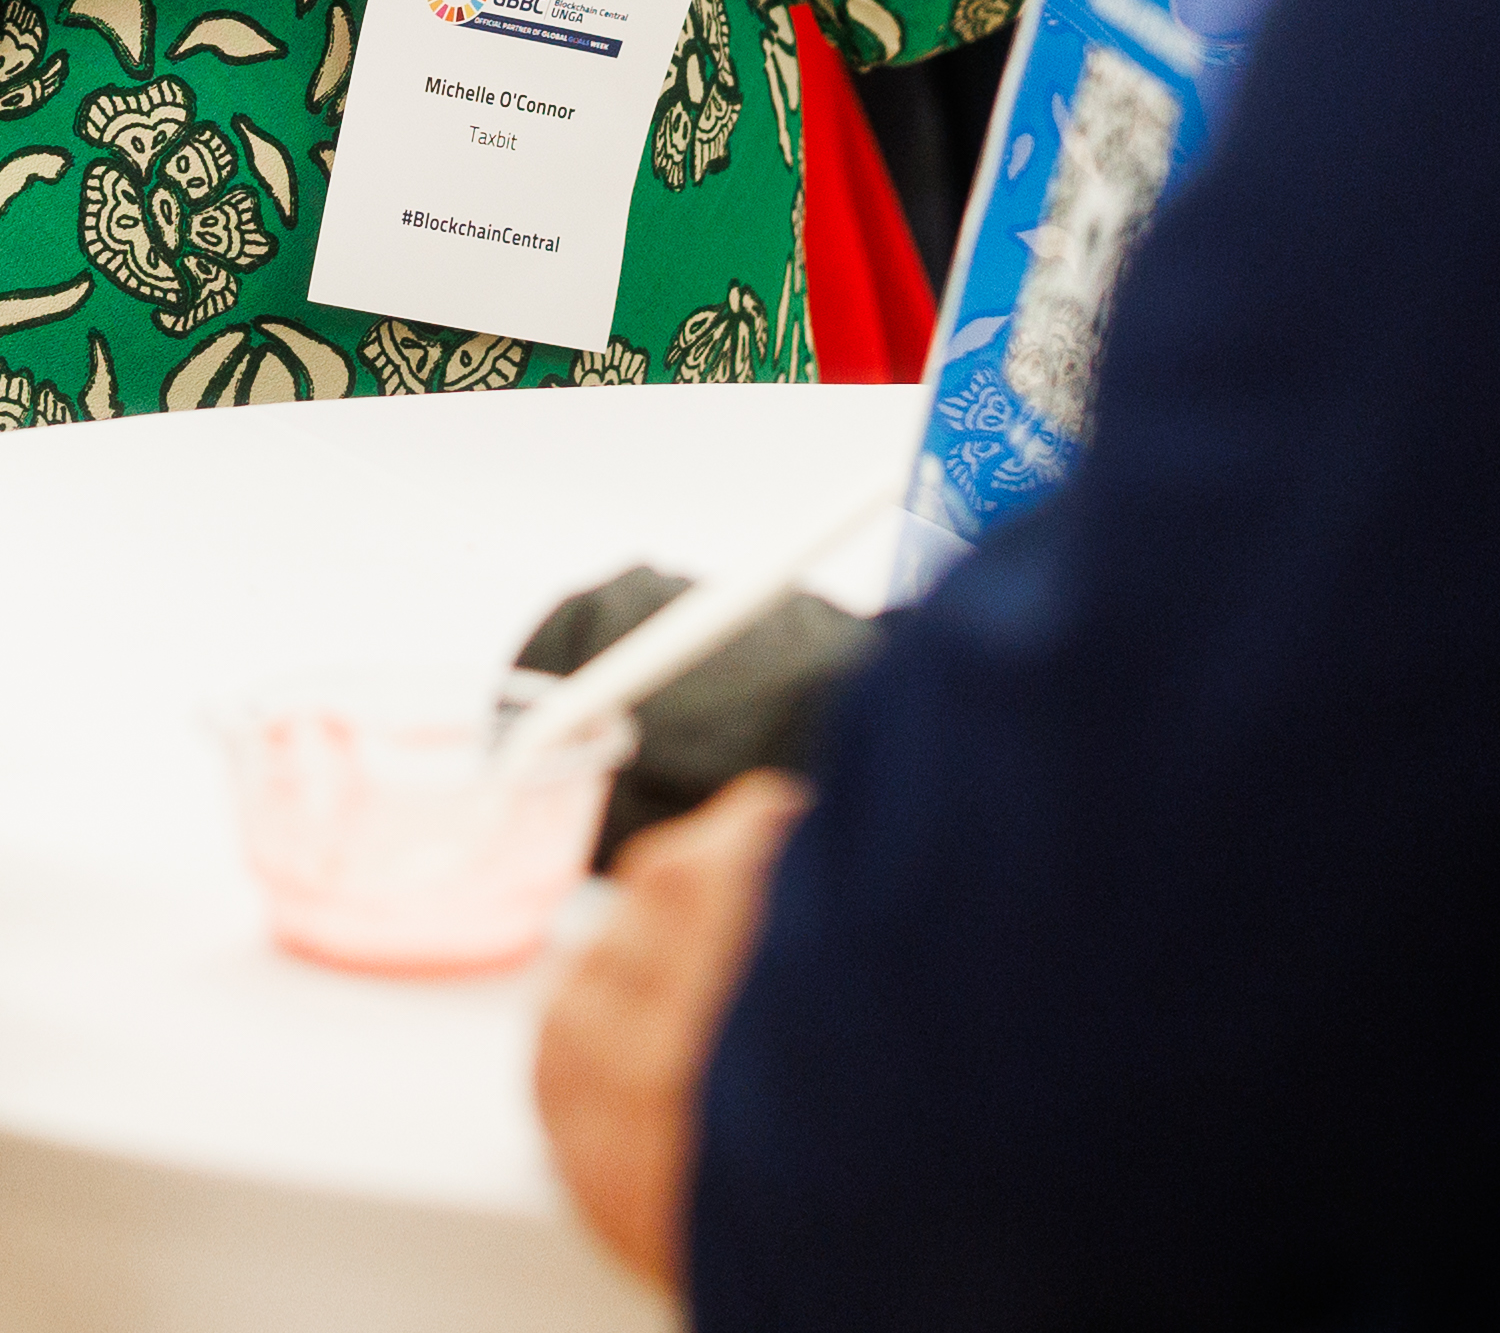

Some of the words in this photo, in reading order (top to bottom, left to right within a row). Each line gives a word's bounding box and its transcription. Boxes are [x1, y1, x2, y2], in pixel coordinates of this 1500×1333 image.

[551, 7, 584, 24] UNGA
[599, 8, 629, 22] Central
[474, 16, 502, 30] OFFICIAL
[502, 21, 533, 35] PARTNER
[532, 27, 542, 37] OF
[541, 30, 568, 43] GLOBAL
[590, 40, 610, 51] WEEK
[424, 76, 496, 107] Michelle
[499, 91, 576, 121] O'Connor
[469, 125, 518, 152] Taxbit
[401, 209, 560, 253] #BlockchainCentral
